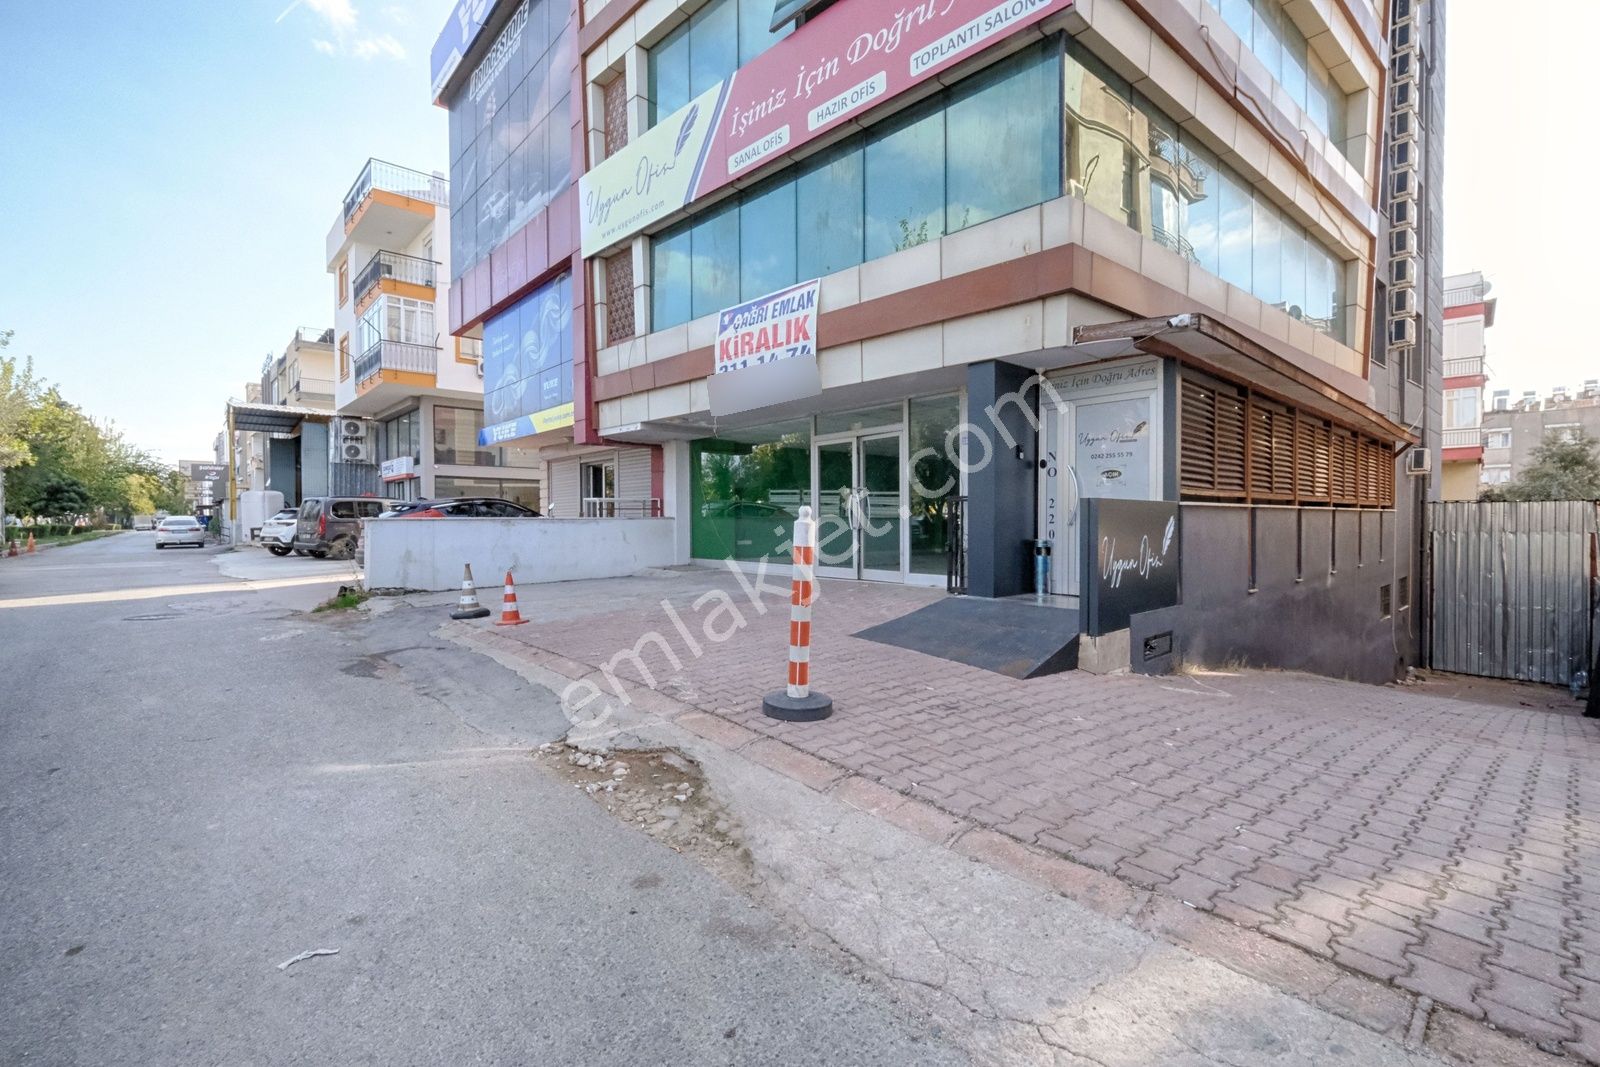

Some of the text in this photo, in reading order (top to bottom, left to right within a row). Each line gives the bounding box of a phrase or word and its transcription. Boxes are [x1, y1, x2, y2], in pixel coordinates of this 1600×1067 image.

[913, 25, 980, 71] TOPLANTI
[984, 0, 1049, 32] SALON
[729, 0, 937, 137] İşiniz İçin Doğru
[816, 80, 876, 123] HAZIR OFİS
[734, 131, 783, 168] SANAL OFİS
[586, 185, 633, 227] Uygun
[733, 289, 816, 333] ÇAĞRI EMLAK
[719, 314, 811, 363] KİRALIK
[1092, 372, 1123, 386] Doğru
[1127, 364, 1156, 380] Adres
[1048, 498, 1056, 540] 220
[1102, 535, 1138, 588] Uygun
